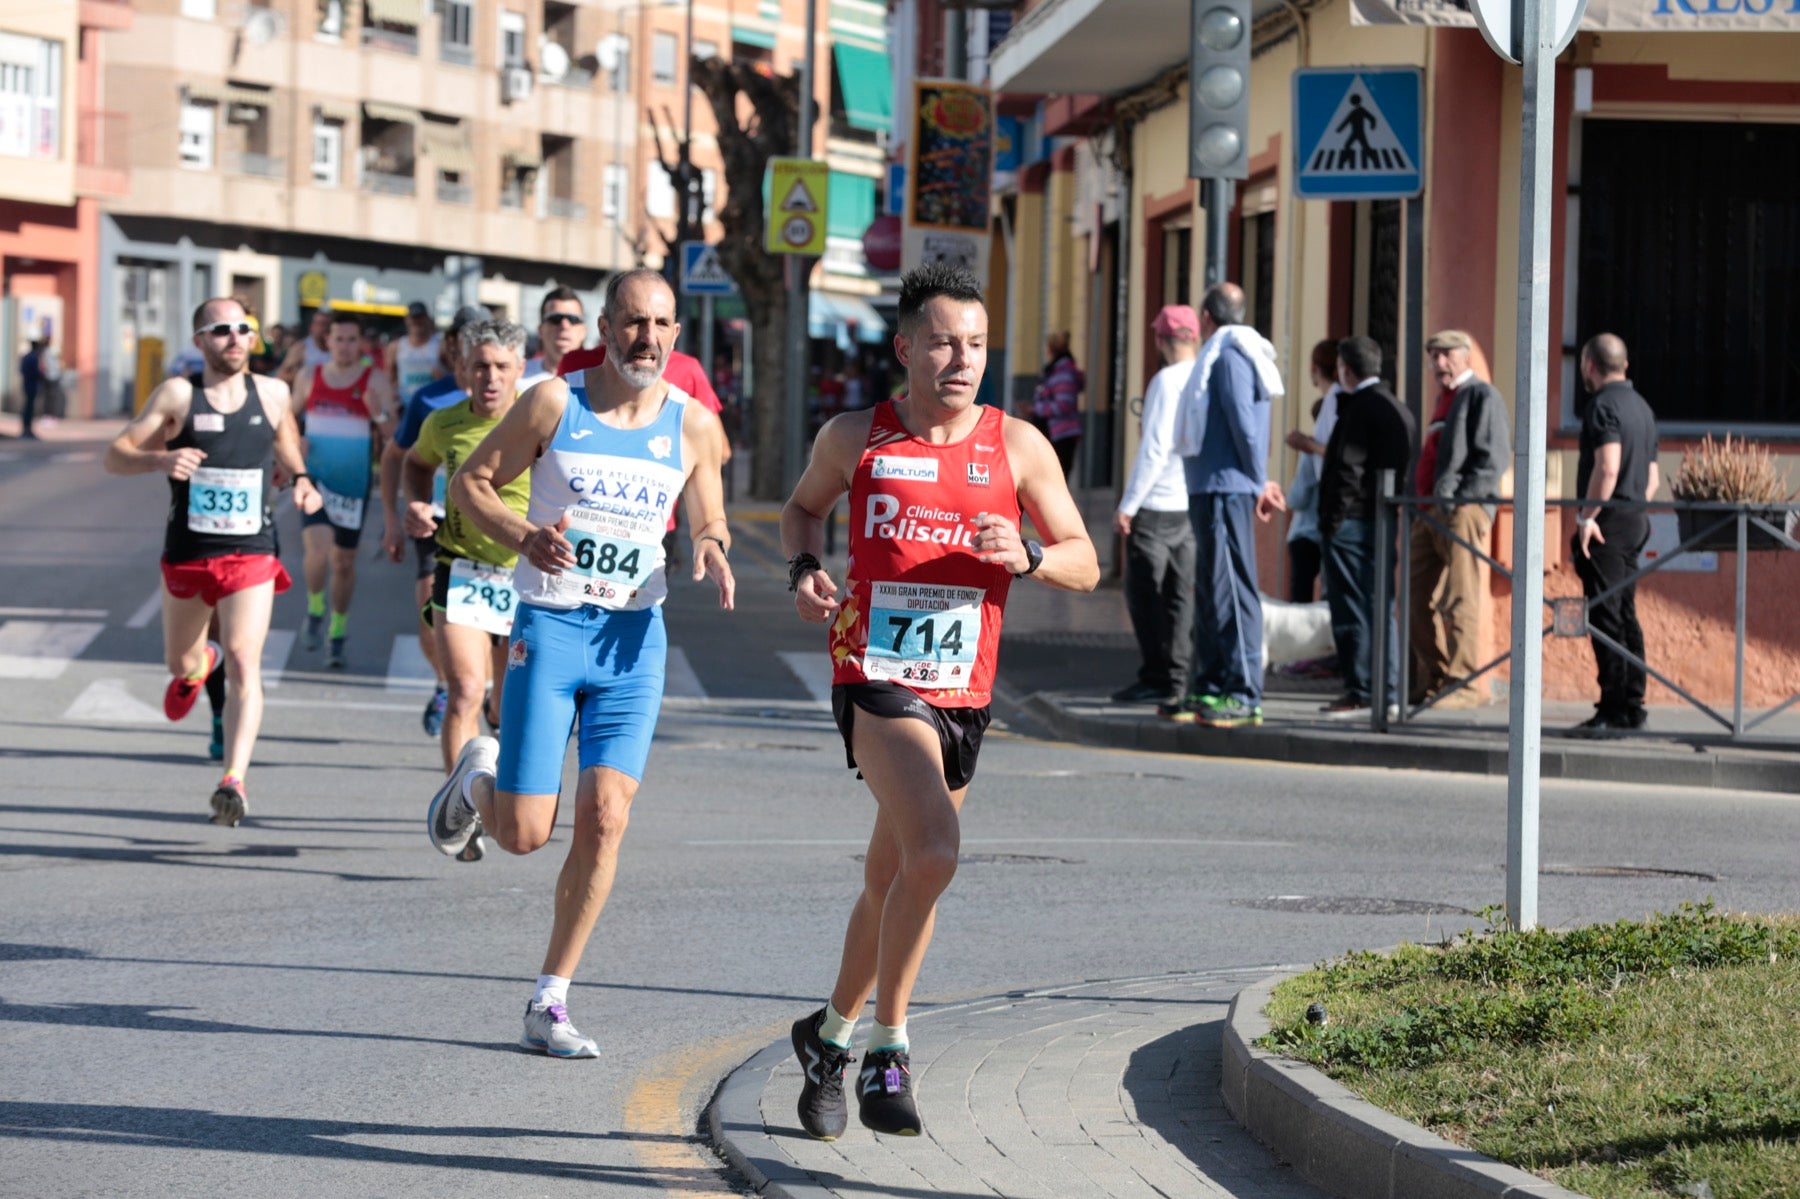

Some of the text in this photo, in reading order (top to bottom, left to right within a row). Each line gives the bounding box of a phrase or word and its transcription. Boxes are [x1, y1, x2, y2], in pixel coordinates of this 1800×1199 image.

[570, 467, 671, 492] CLUB ATLETISMO
[968, 475, 988, 483] MOVE
[203, 489, 248, 512] 333
[569, 477, 668, 510] CAXAR
[590, 512, 606, 523] GRAN
[607, 515, 629, 529] PREMIO
[629, 520, 637, 530] DE
[864, 493, 979, 548] Polisalu
[906, 506, 961, 522] Clínicas
[574, 538, 640, 579] 684
[879, 584, 978, 601] XXXIII GRAN PREMIO DE FONDO
[888, 616, 963, 656] 714
